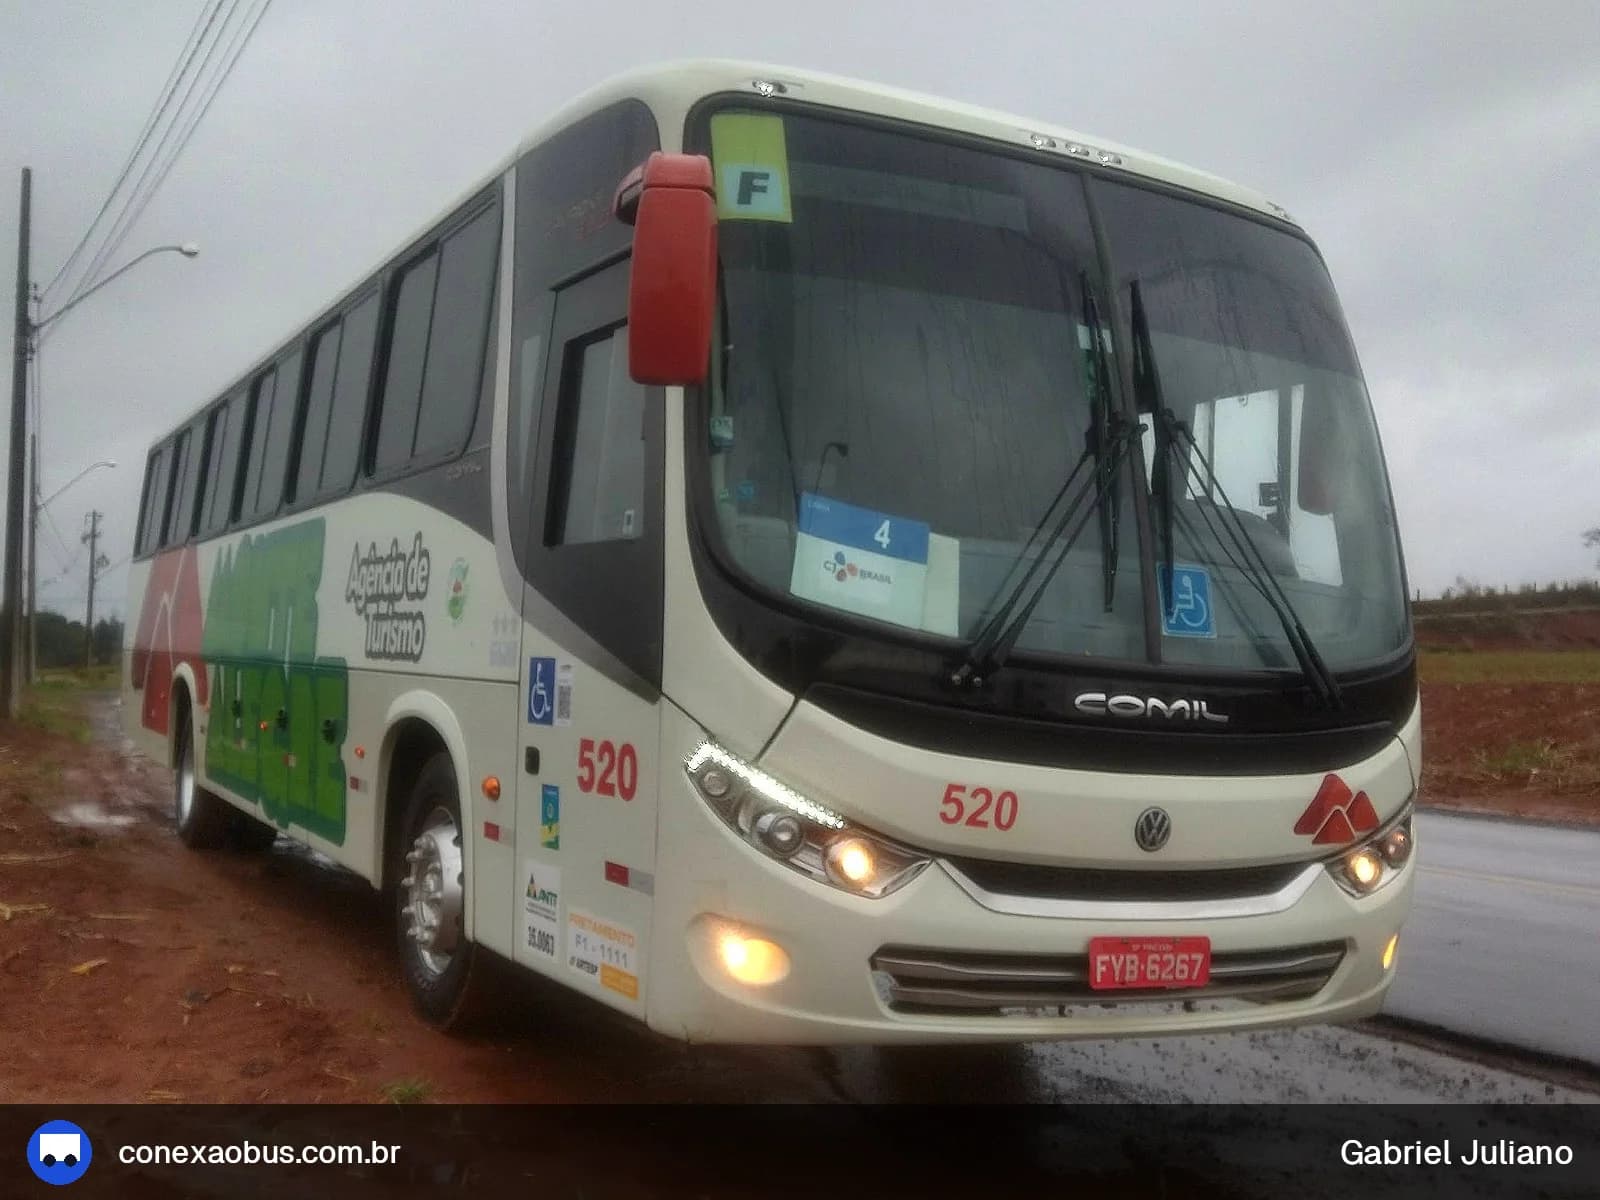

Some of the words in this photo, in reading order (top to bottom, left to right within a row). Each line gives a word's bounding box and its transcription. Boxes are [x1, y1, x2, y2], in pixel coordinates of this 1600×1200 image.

[737, 171, 769, 205] F
[874, 519, 891, 549] 4
[405, 530, 430, 600] de
[364, 600, 425, 662] Turismo
[1073, 692, 1230, 723] COMIL
[576, 737, 638, 802] 520
[938, 782, 1019, 832] 520
